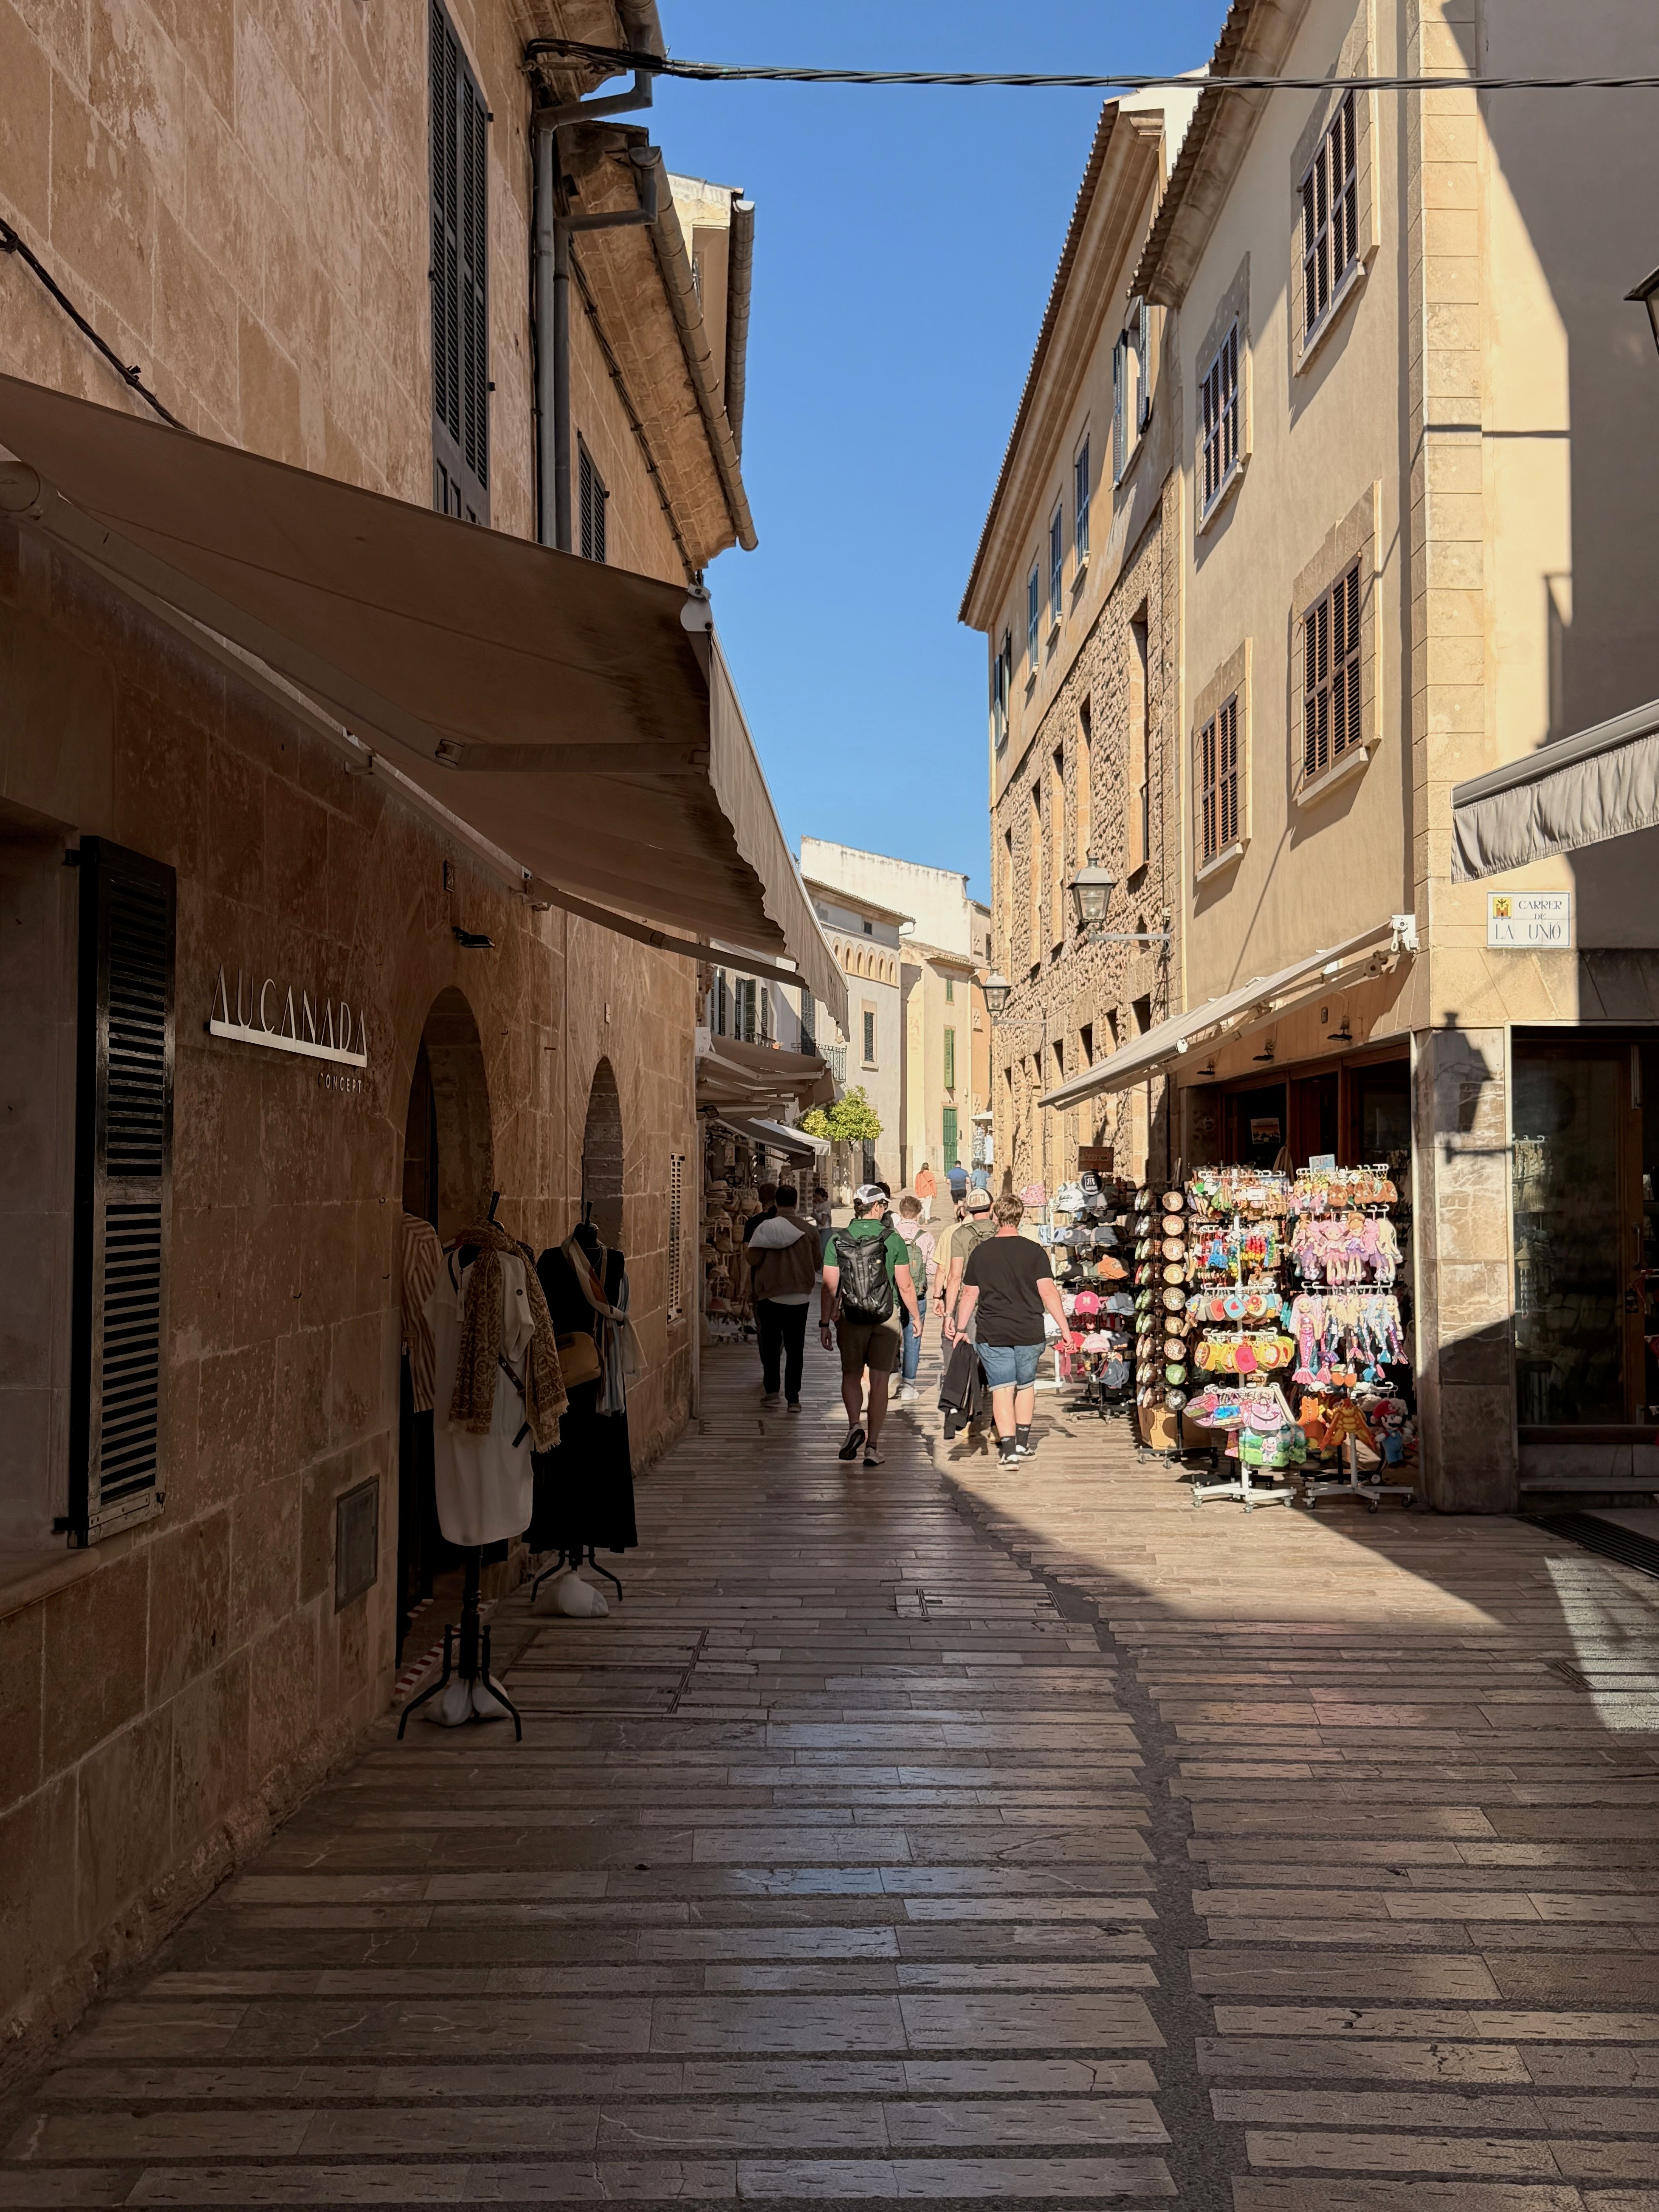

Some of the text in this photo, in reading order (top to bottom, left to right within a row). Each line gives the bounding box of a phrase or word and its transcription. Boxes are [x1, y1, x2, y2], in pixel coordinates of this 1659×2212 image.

[1518, 900, 1562, 909] CARRER
[1496, 924, 1514, 939] LA
[211, 963, 367, 1060] AUCANADA
